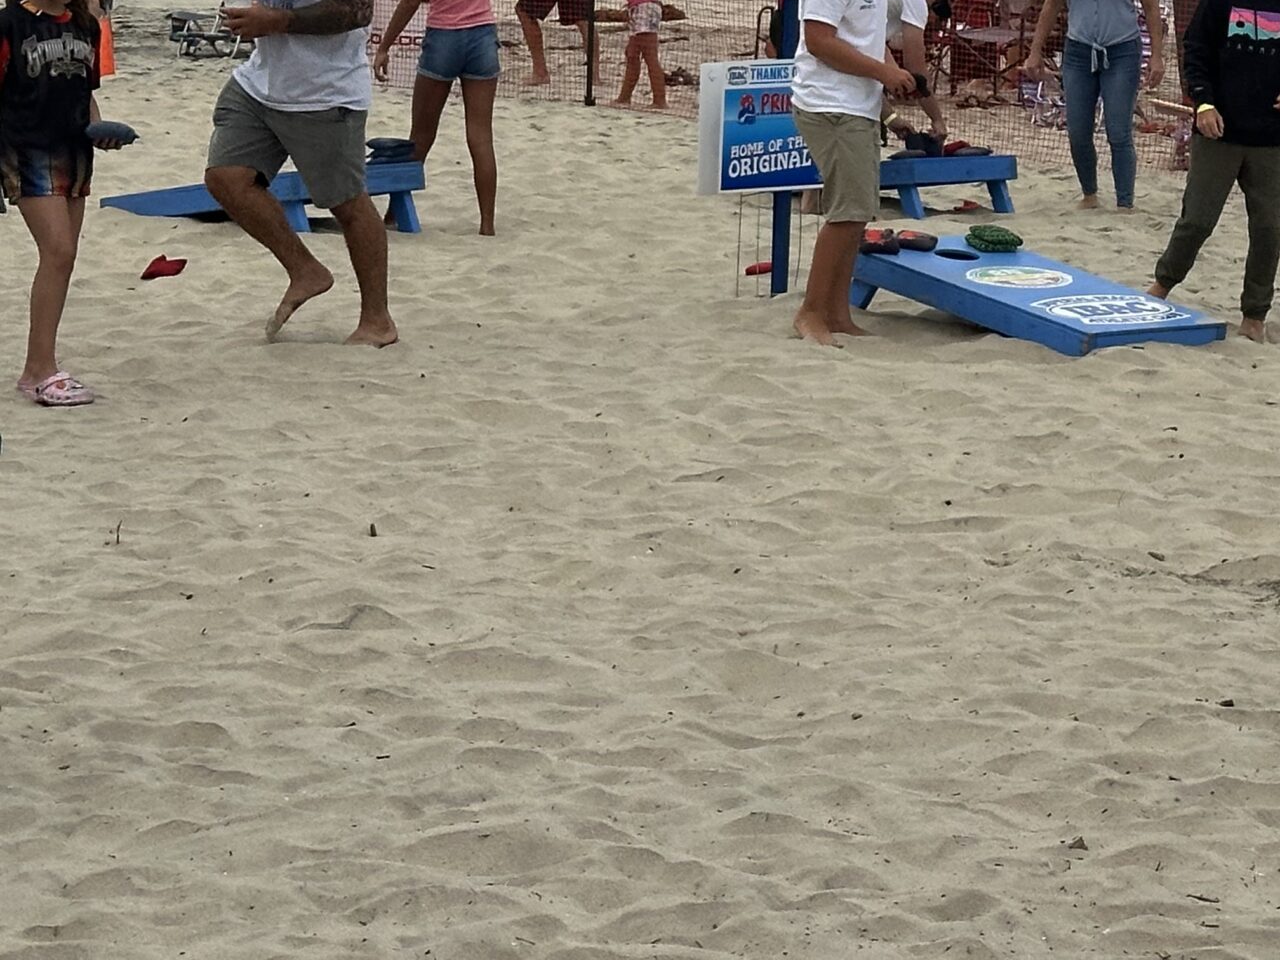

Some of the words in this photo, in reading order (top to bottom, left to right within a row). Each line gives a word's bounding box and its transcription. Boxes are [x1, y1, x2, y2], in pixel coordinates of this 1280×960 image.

[750, 67, 790, 80] THANKS
[730, 142, 765, 159] HOME
[768, 139, 783, 152] OF
[728, 149, 812, 178] ORIGINAL
